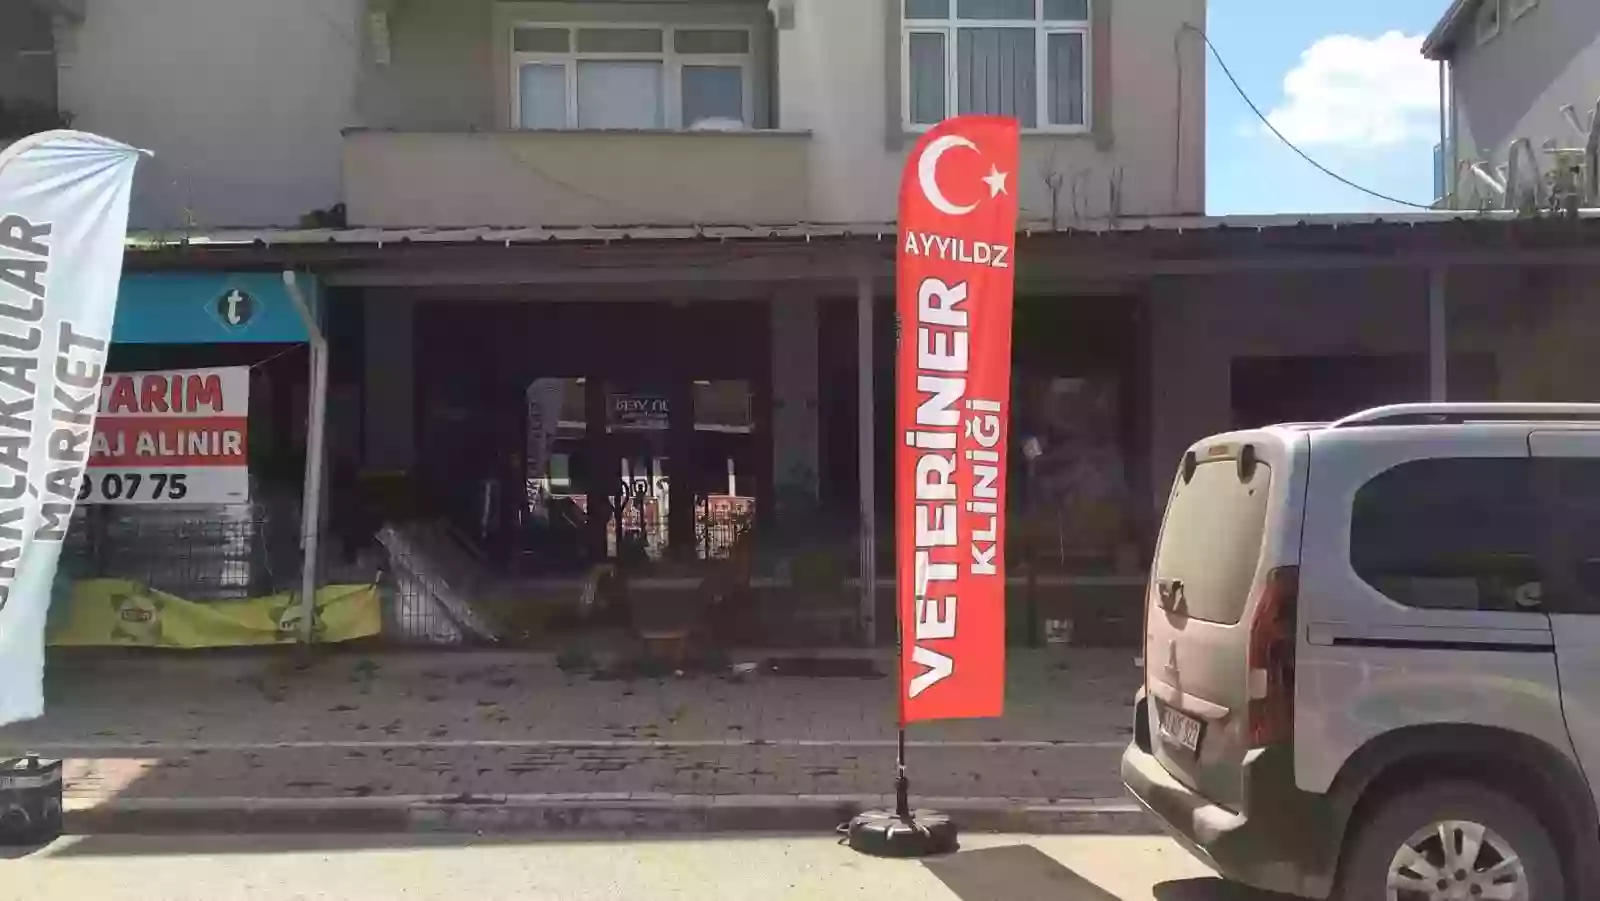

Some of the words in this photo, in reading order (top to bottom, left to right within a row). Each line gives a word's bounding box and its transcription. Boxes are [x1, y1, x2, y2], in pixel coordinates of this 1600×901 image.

[34, 321, 105, 541] MARKET
[101, 473, 142, 500] 07
[149, 473, 187, 500] 75
[136, 429, 242, 456] ALINIR
[906, 277, 969, 700] VETERİNER
